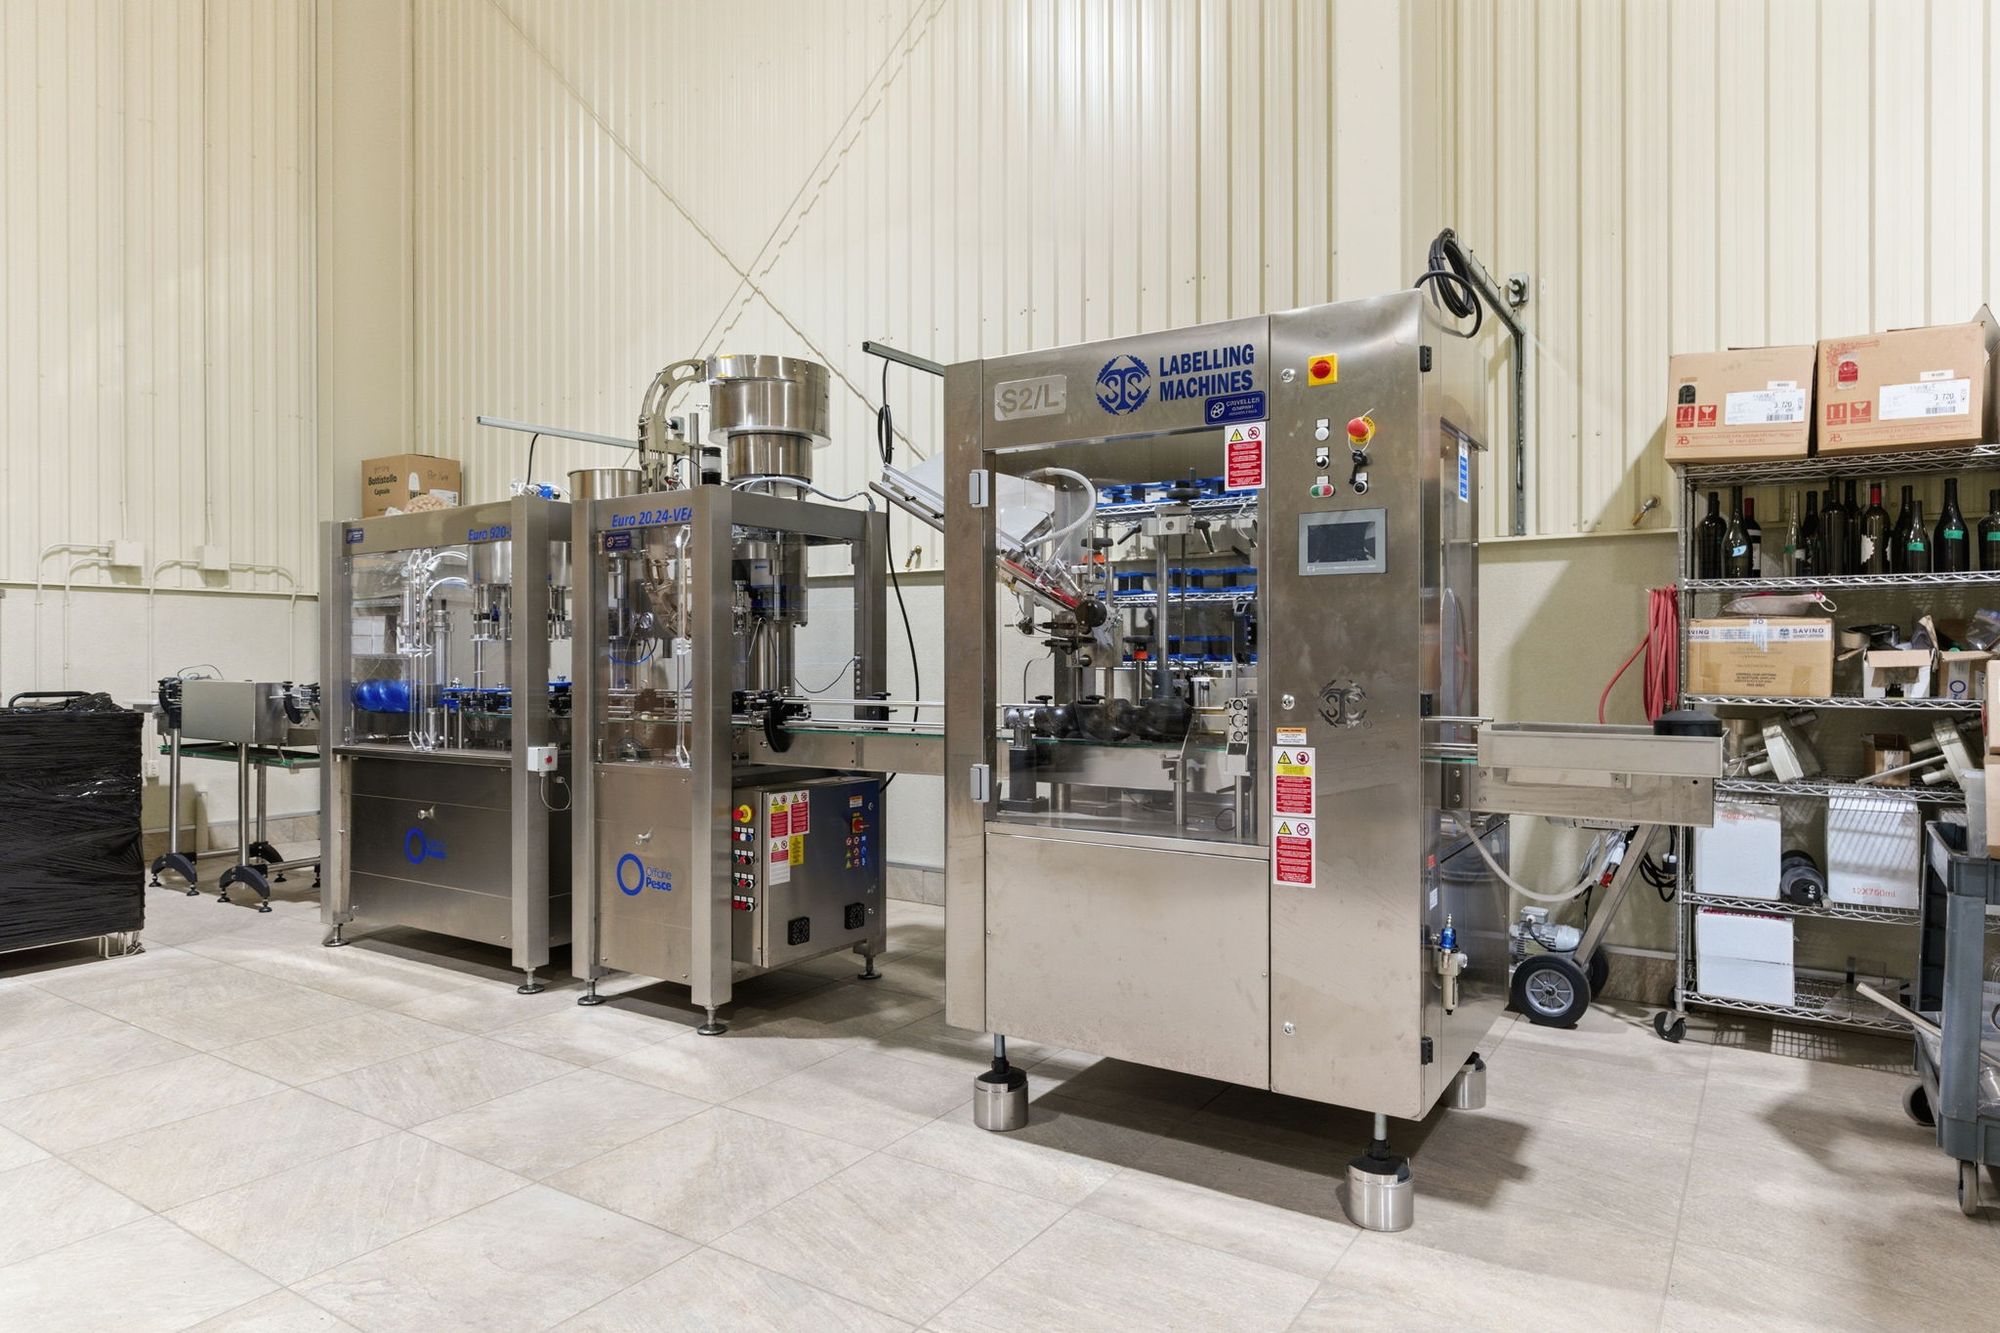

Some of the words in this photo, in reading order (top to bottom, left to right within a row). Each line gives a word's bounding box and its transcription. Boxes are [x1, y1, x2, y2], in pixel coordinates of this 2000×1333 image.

[1160, 344, 1254, 377] LABELLING
[1160, 370, 1253, 402] MACHINES
[1001, 384, 1060, 414] S2/L
[612, 514, 636, 527] Euro
[468, 529, 487, 541] Euro
[646, 877, 672, 891] Pesce
